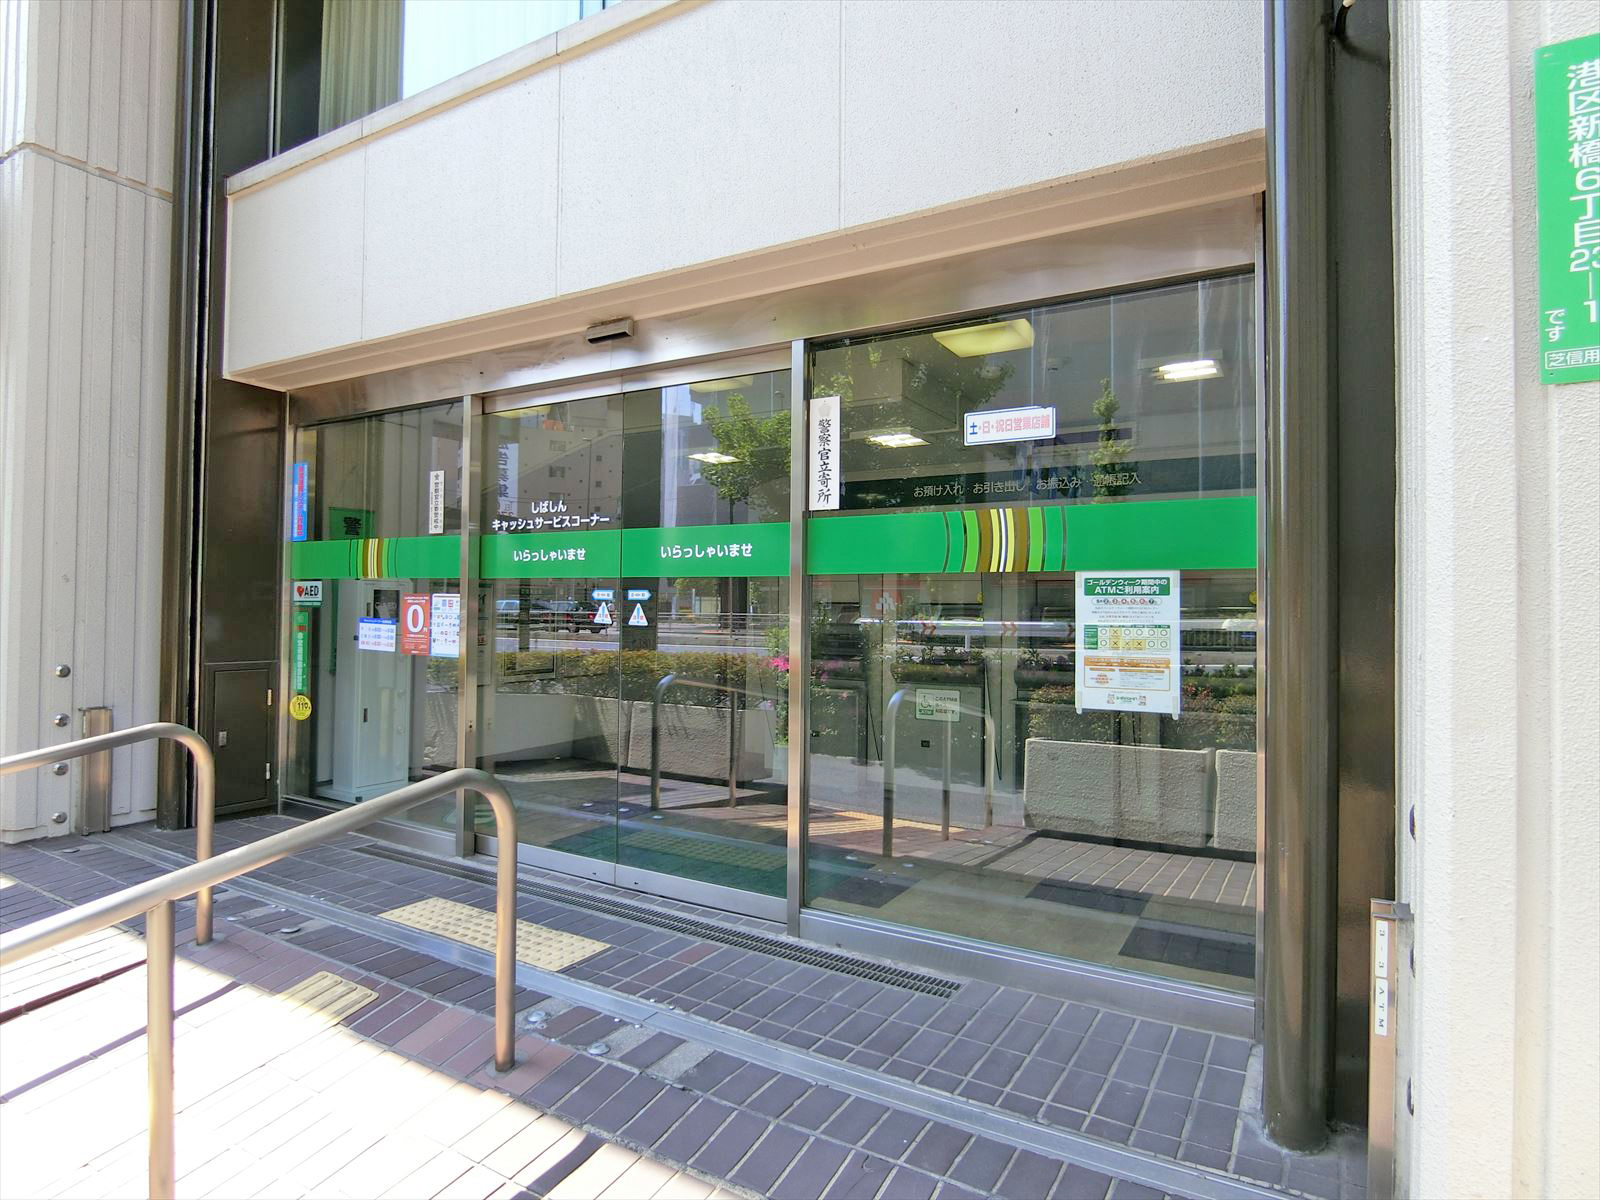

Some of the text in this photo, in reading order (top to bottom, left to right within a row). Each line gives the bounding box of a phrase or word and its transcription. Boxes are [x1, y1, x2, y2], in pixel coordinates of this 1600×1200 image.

[1545, 309, 1565, 342] です
[1548, 350, 1600, 367] 芝信用
[817, 418, 832, 504] 警察官立寄所
[531, 500, 567, 514] しばしん
[492, 513, 610, 531] キャッシュサービスコーナー
[513, 548, 586, 562] いらっしゃいませ
[660, 543, 752, 559] いらっしゃいませ
[305, 585, 319, 596] AED
[1094, 585, 1160, 595] ATMご利用案内
